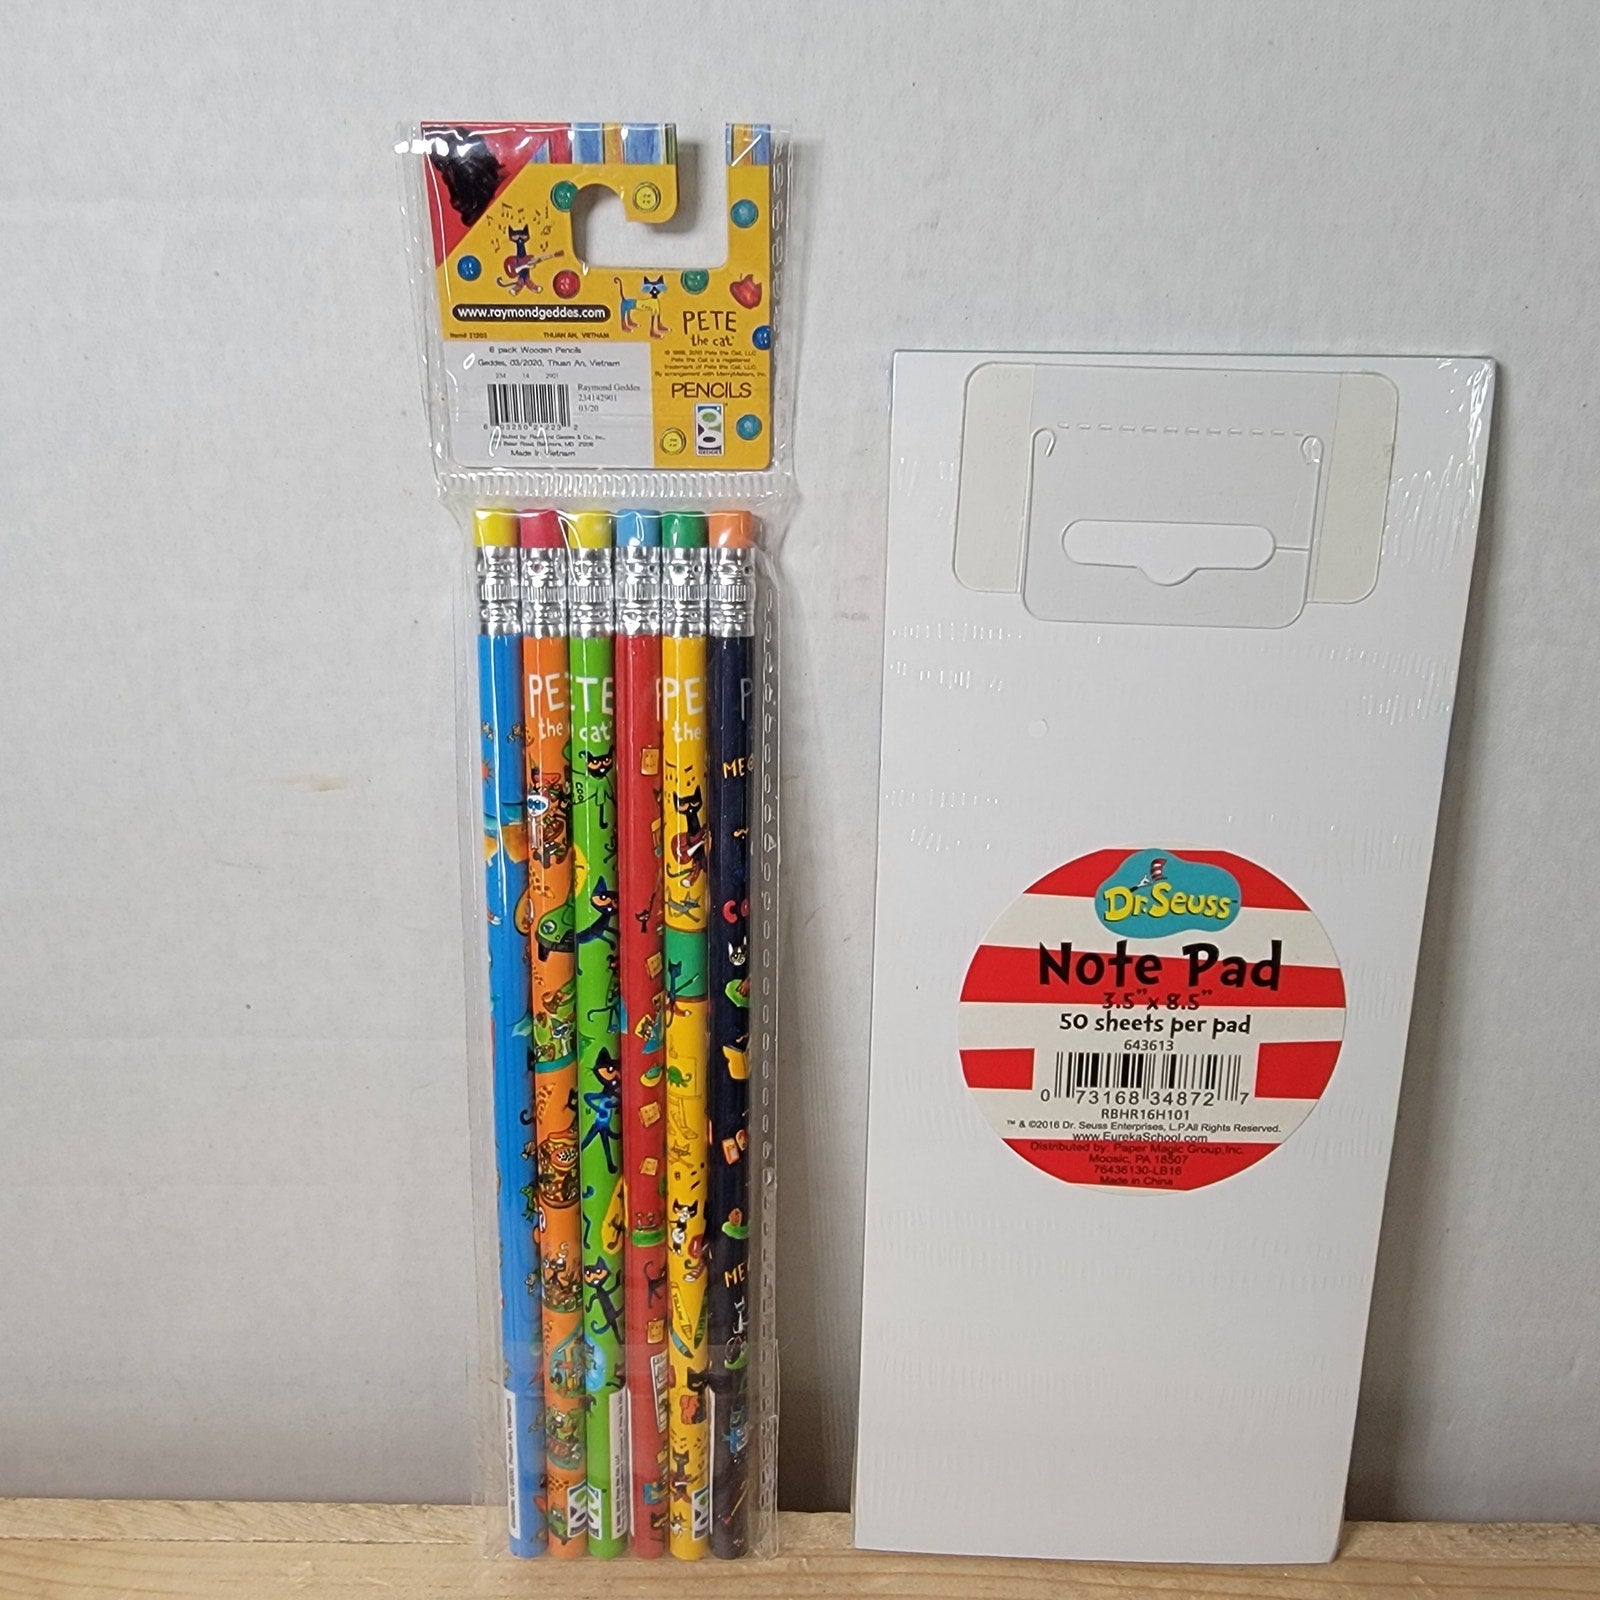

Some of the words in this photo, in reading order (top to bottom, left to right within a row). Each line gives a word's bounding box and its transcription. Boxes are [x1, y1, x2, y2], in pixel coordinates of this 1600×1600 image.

[458, 305, 606, 320] www.raymondgeddes.com
[682, 310, 737, 335] PETE
[690, 334, 709, 347] the
[498, 346, 518, 354] pack
[520, 346, 552, 354] Wooden
[555, 346, 581, 354] Pencils
[590, 359, 620, 367] Vietnam
[577, 383, 612, 392] Raymond
[613, 383, 640, 391] Geddes
[671, 382, 752, 399] PENCILS
[578, 404, 599, 412] 03/20
[538, 717, 563, 740] the
[672, 720, 701, 743] the
[1038, 939, 1163, 988] Note
[1182, 939, 1283, 992] Pad
[1059, 1013, 1089, 1031] 50
[1094, 1011, 1164, 1032] sheets
[1170, 1017, 1207, 1039] per
[1212, 1014, 1251, 1040] pad
[1123, 1040, 1174, 1051] 643613
[1040, 1089, 1050, 1102] 0
[1076, 1090, 1140, 1105] 73168
[1150, 1091, 1214, 1107] 34872
[1239, 1092, 1249, 1105] 7
[1101, 1109, 1189, 1121] RBHR16H101
[1063, 1121, 1076, 1129] Dr.
[1079, 1122, 1108, 1130] Seuss
[1111, 1122, 1166, 1131] Enterprises,
[1201, 1124, 1231, 1133] Rights
[1234, 1124, 1281, 1133] Reserved.
[1072, 1132, 1208, 1143] www.EurekaSchool.com
[1030, 1142, 1090, 1152] Distributed
[1114, 1143, 1146, 1154] Paper
[1150, 1144, 1183, 1155] Magic
[1100, 1176, 1128, 1185] Made
[1131, 1176, 1140, 1185] in
[1143, 1177, 1173, 1186] China
